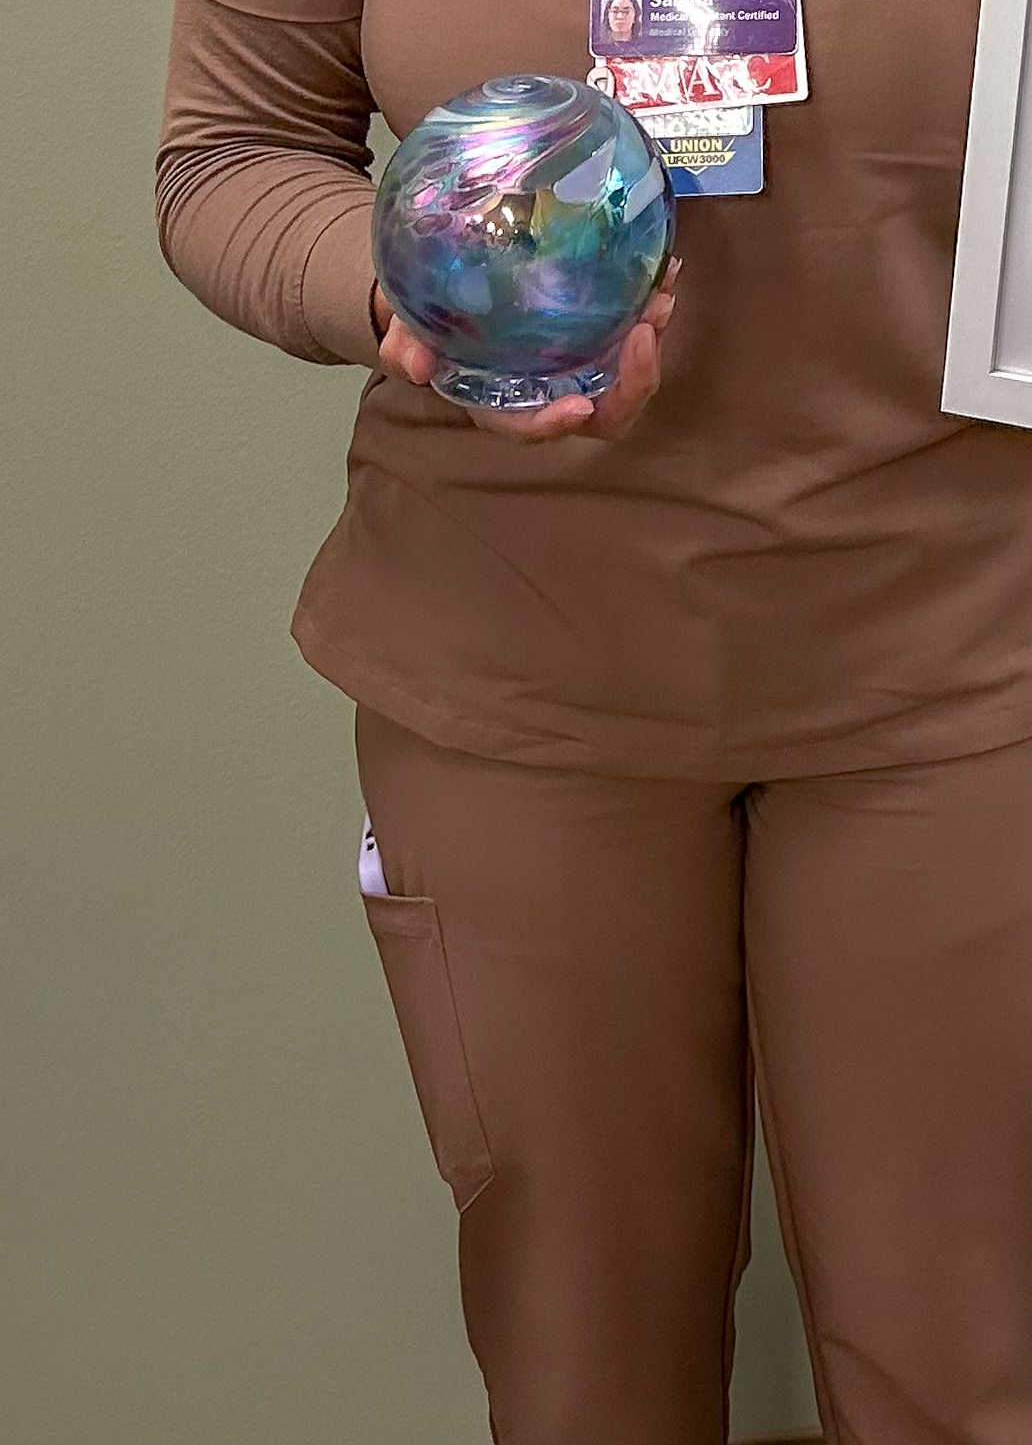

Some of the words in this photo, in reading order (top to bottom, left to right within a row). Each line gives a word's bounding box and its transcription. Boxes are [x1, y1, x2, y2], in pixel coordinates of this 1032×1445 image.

[738, 10, 779, 21] Certified
[670, 139, 723, 152] UNION
[668, 154, 698, 165] UFCW
